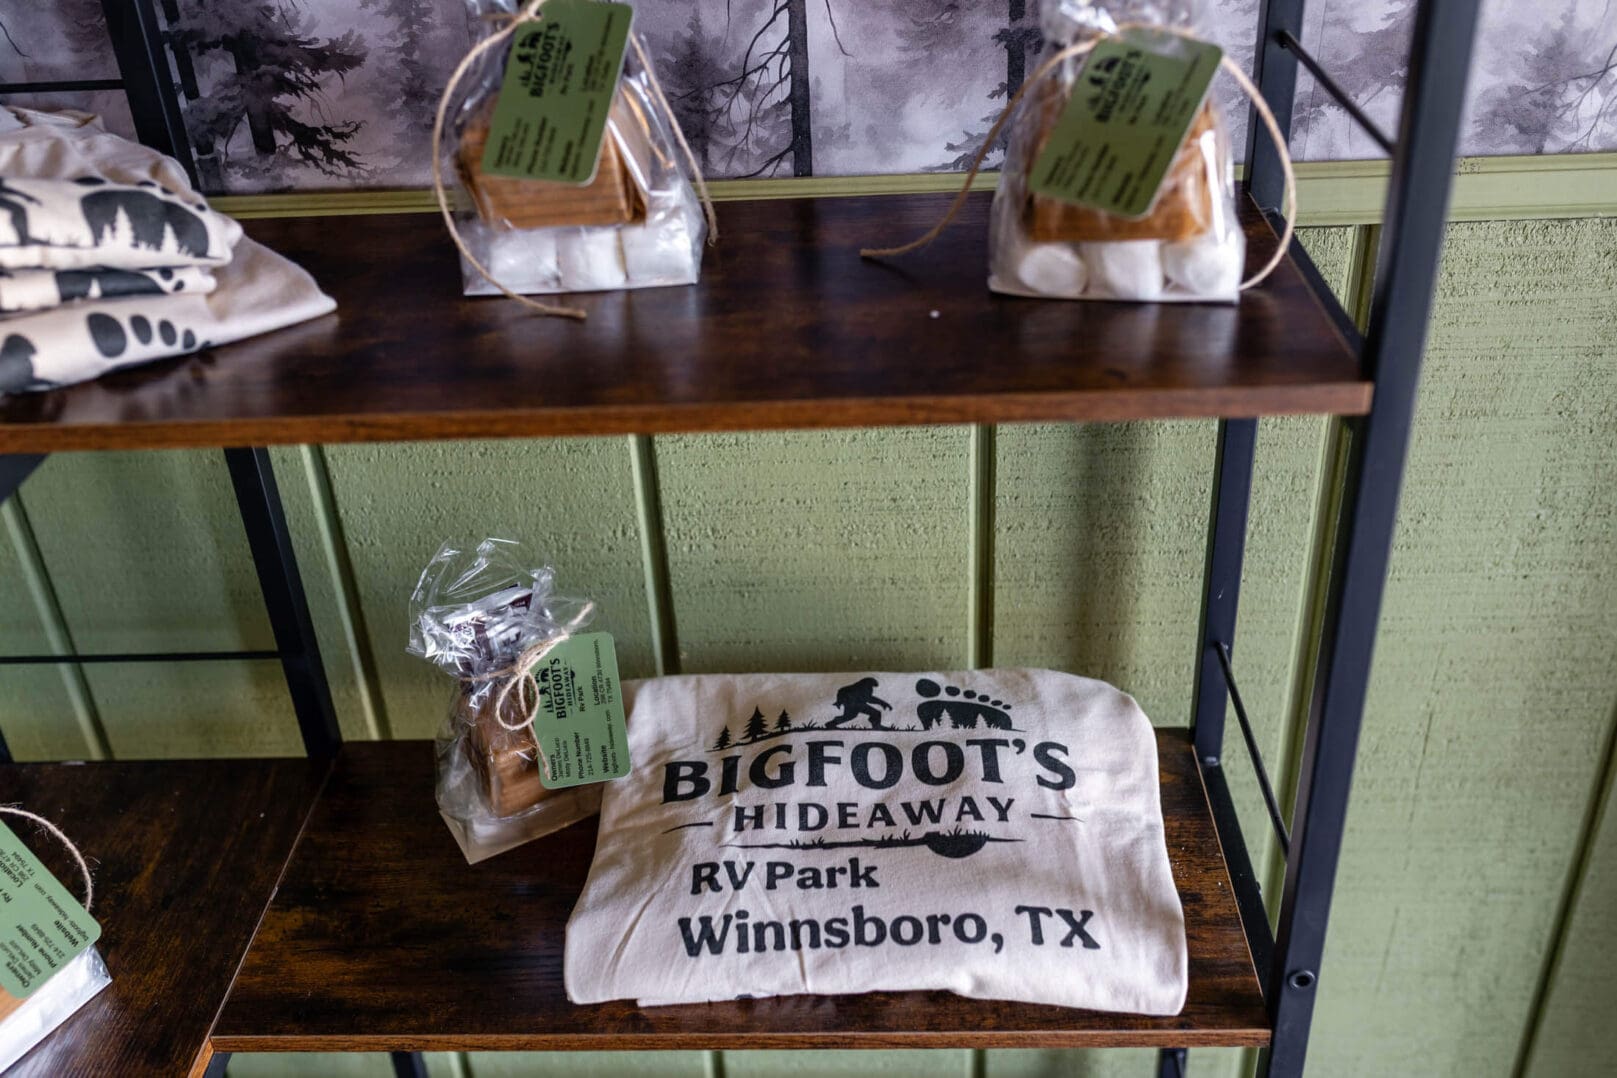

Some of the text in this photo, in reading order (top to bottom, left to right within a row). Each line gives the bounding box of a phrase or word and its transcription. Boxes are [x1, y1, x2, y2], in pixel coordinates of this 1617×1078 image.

[549, 657, 567, 719] BIGFOOT'S
[563, 666, 572, 706] HIDEAWAY
[660, 739, 1077, 804] BIGFOOT'S
[733, 797, 1016, 832] HIDEAWAY
[690, 857, 880, 896] RV Park
[15, 924, 57, 968] Phone Number
[53, 920, 79, 947] Website
[677, 905, 1101, 959] Winnsboro, TX
[6, 961, 30, 988] Owners
